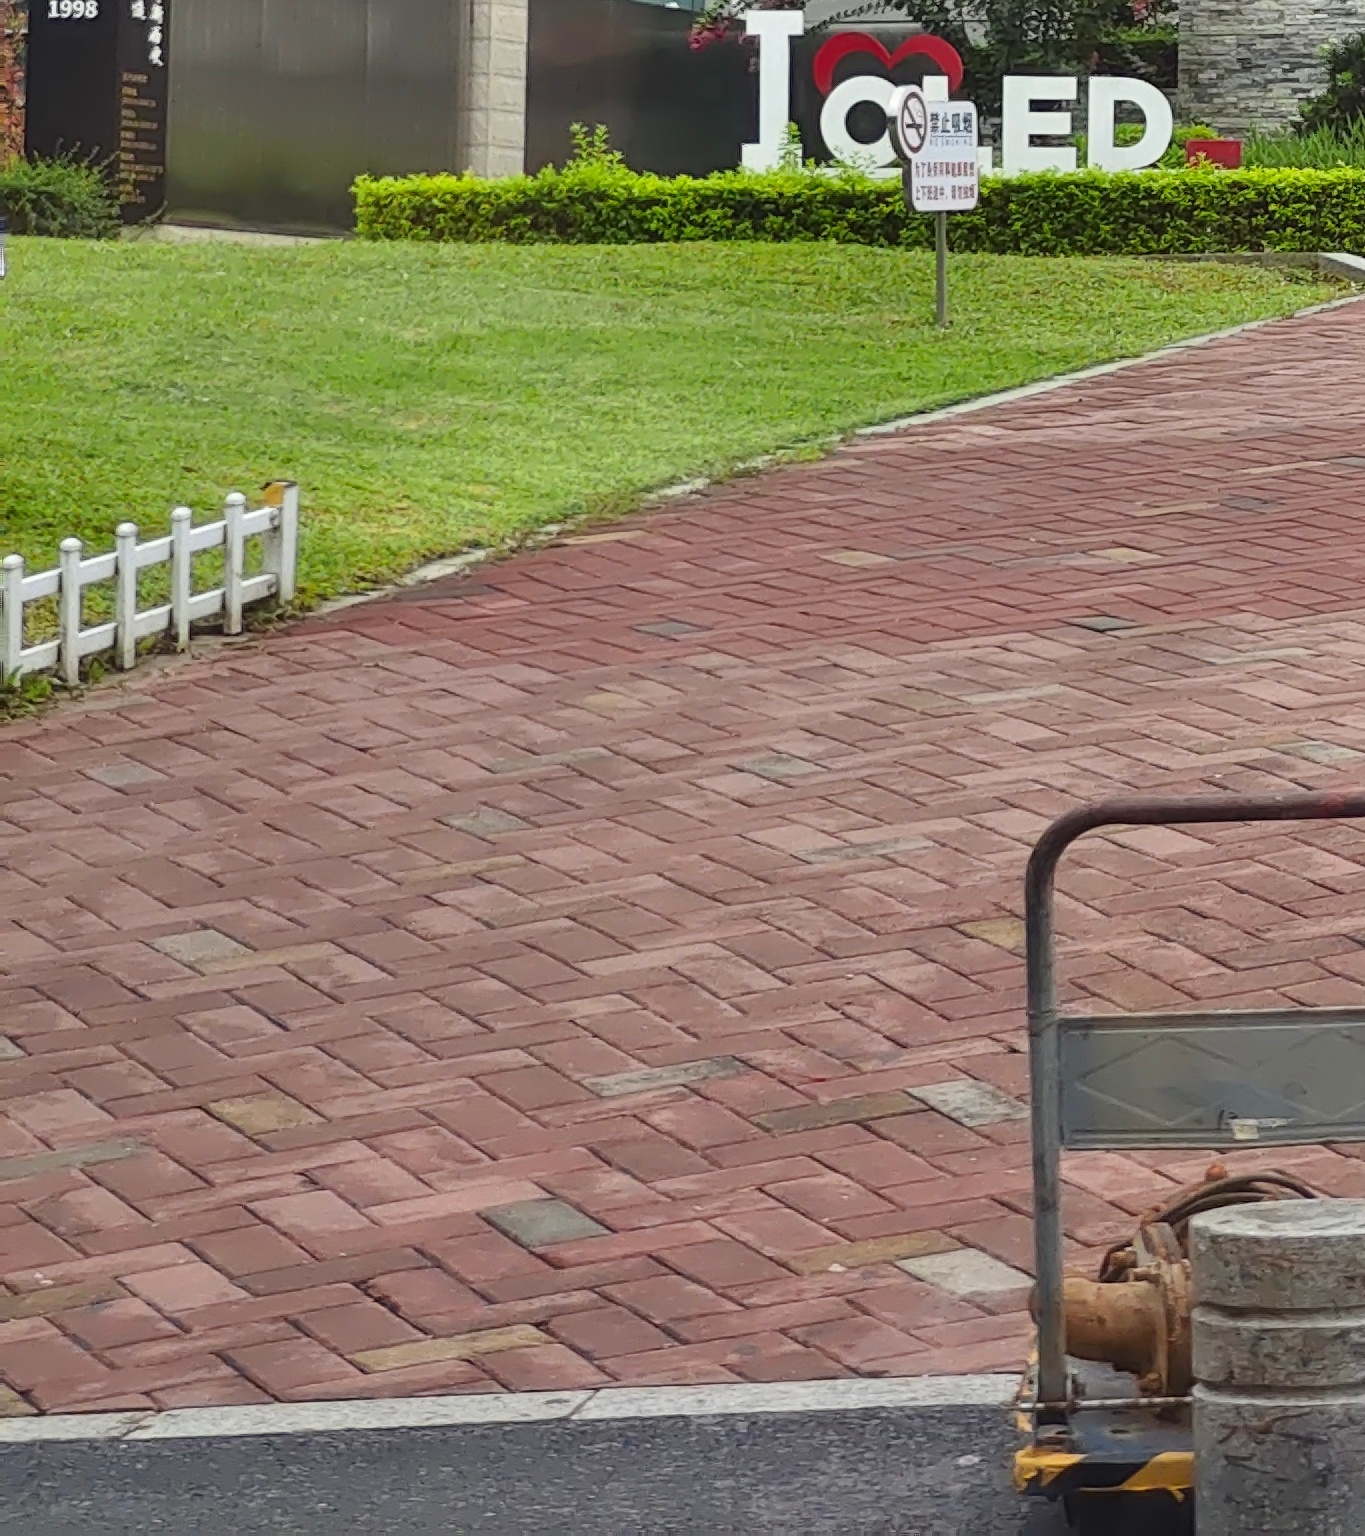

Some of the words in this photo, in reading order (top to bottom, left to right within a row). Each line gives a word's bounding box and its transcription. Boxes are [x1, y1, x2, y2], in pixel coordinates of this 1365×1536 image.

[47, 0, 99, 20] 1998
[741, 9, 805, 172] I
[929, 111, 973, 134] 禁止吸烟
